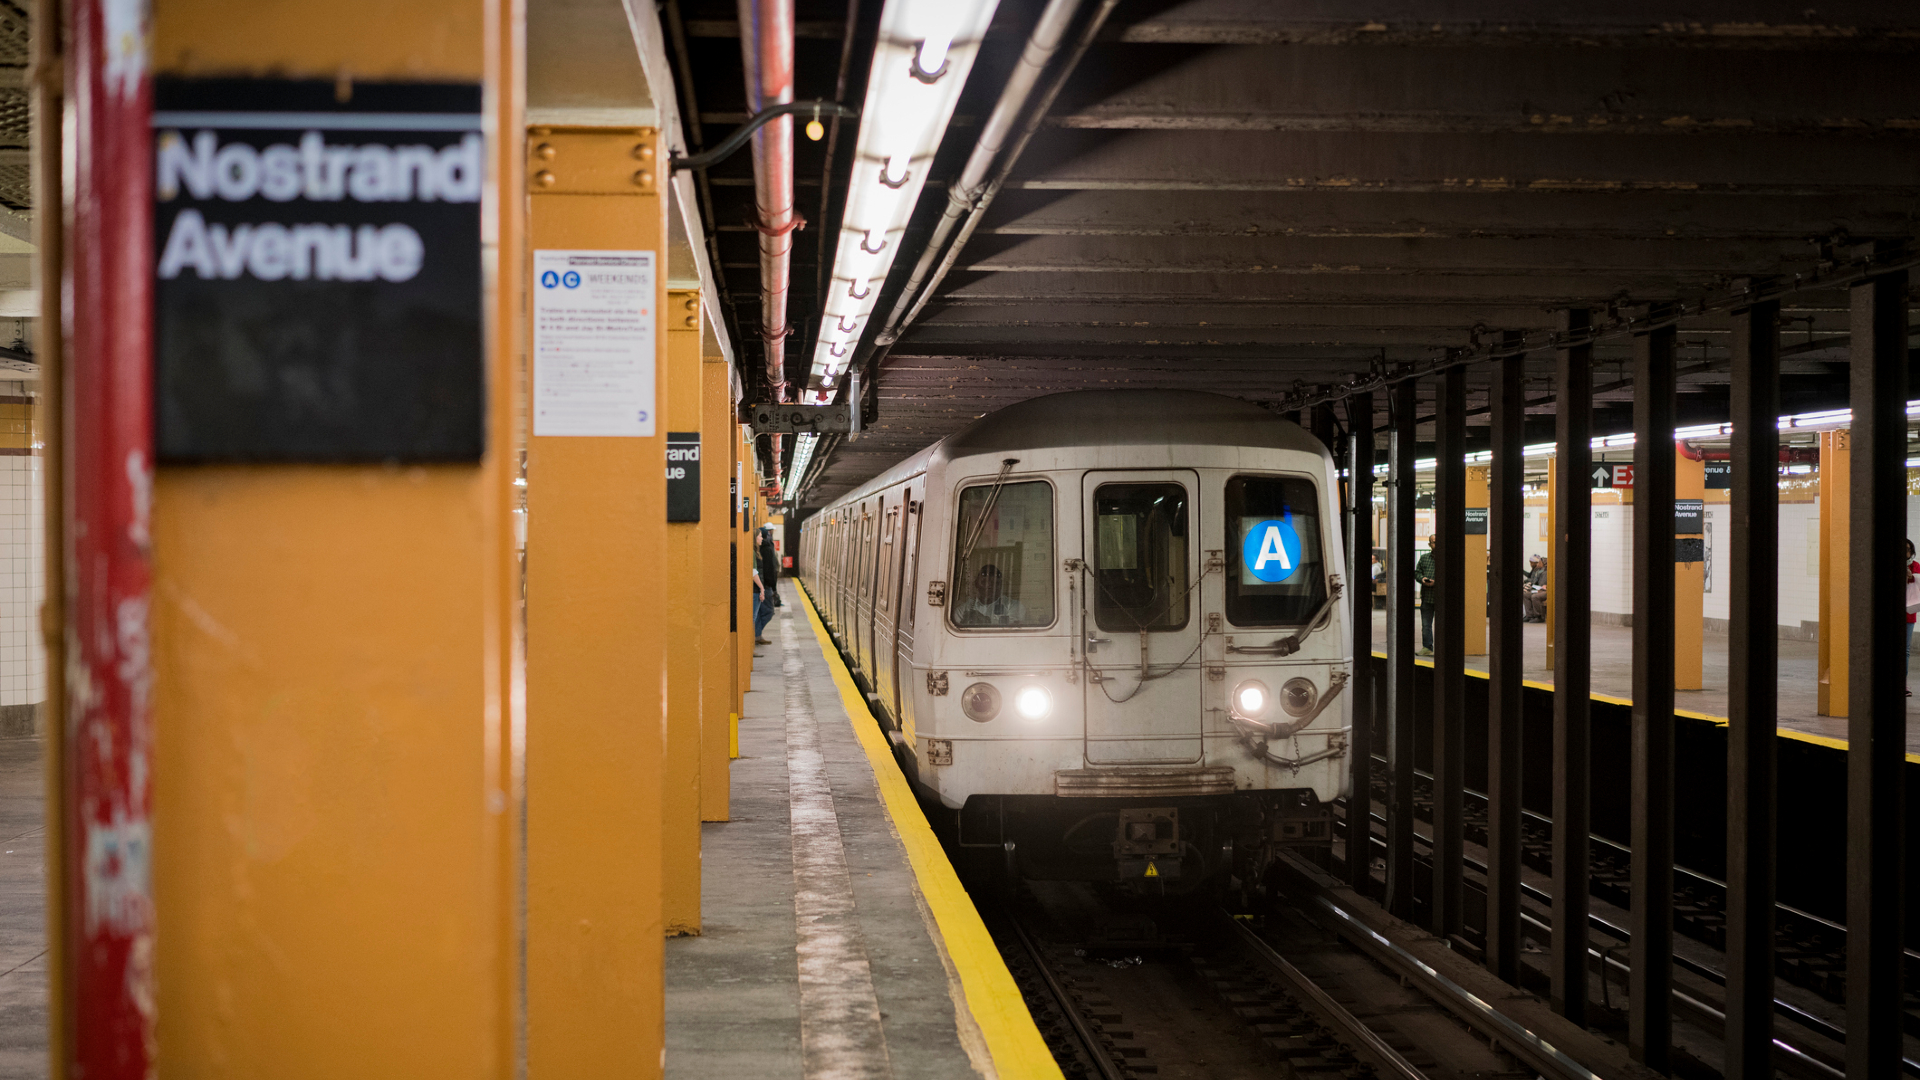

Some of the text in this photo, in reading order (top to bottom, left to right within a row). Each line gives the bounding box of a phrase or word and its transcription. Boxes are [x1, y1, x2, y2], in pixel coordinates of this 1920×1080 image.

[158, 131, 483, 202] Nostrand
[158, 209, 425, 282] Avenue
[589, 273, 648, 285] WEEKENDS
[1254, 526, 1291, 570] A
